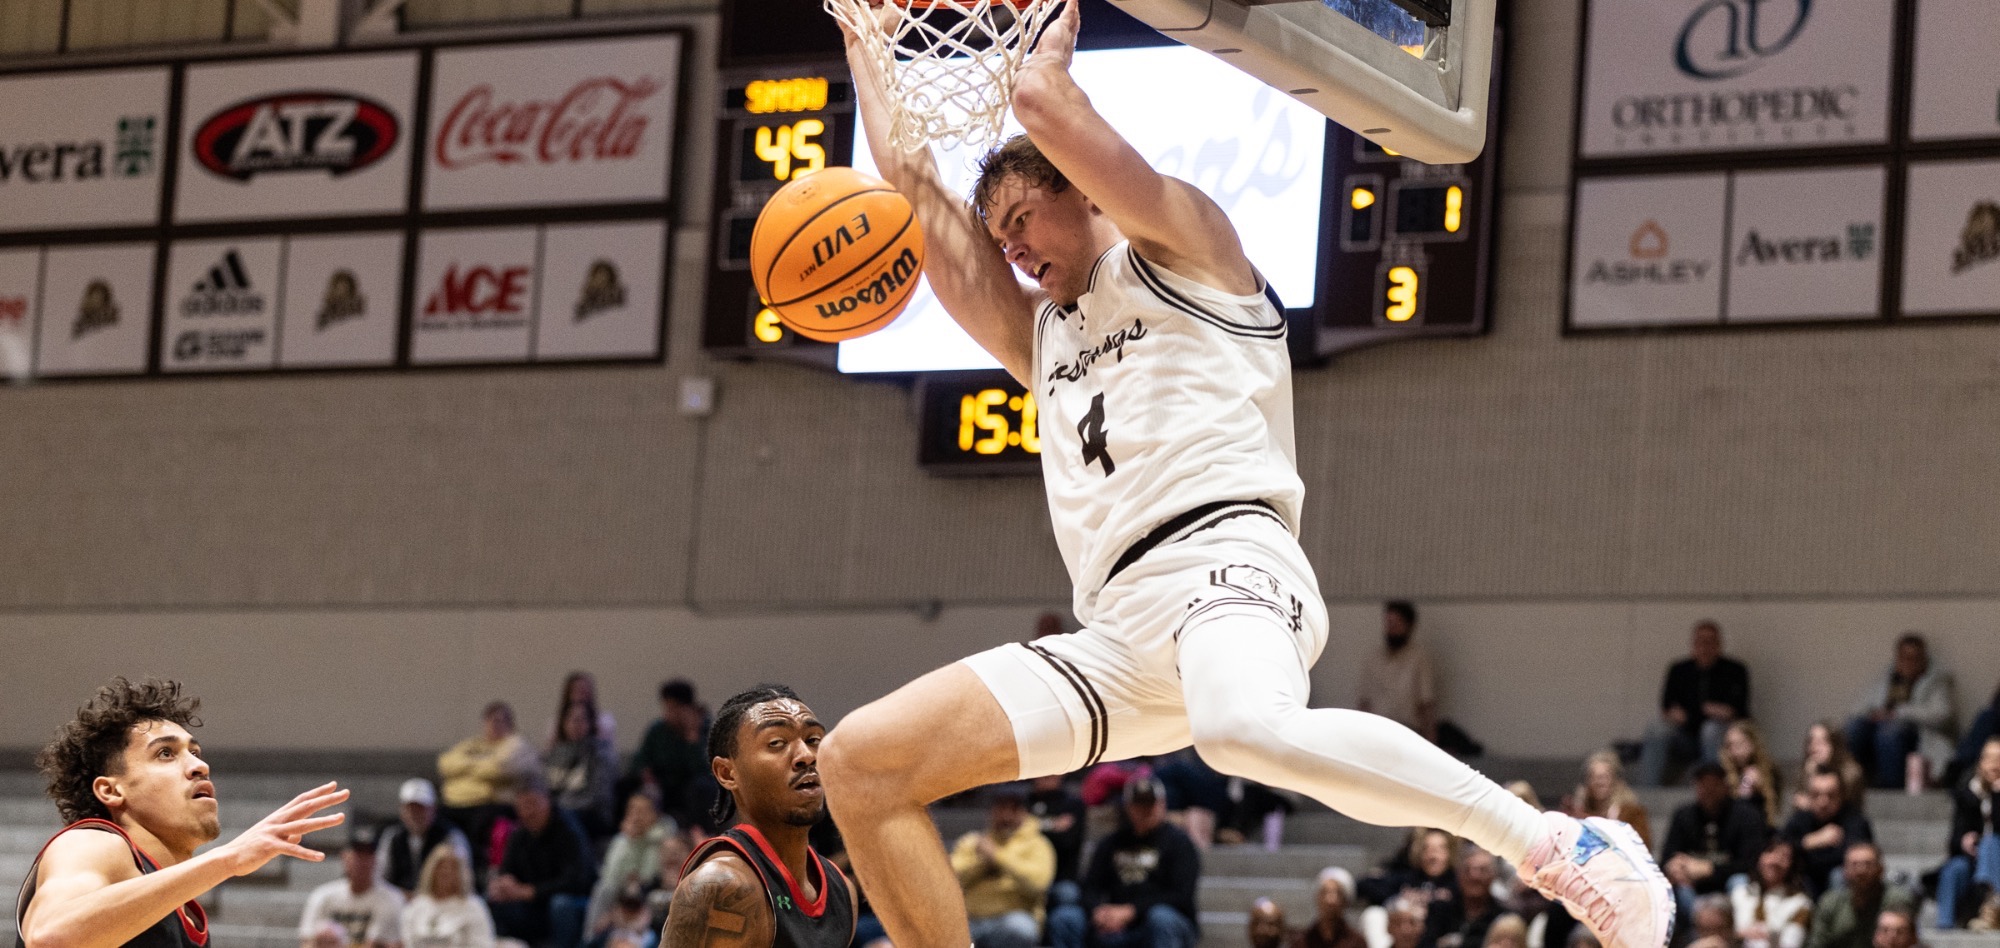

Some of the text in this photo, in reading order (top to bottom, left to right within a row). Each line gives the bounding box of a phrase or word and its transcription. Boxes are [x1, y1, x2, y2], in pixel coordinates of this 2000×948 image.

[1611, 84, 1858, 128] ORTHOPEDIC
[229, 99, 359, 168] ATZ
[755, 119, 826, 181] 45
[1444, 185, 1463, 233] 1
[1736, 228, 1840, 266] Avera
[423, 262, 529, 315] ACE
[815, 247, 918, 318] Wilson
[1386, 267, 1418, 321] 3
[1077, 391, 1116, 478] 4
